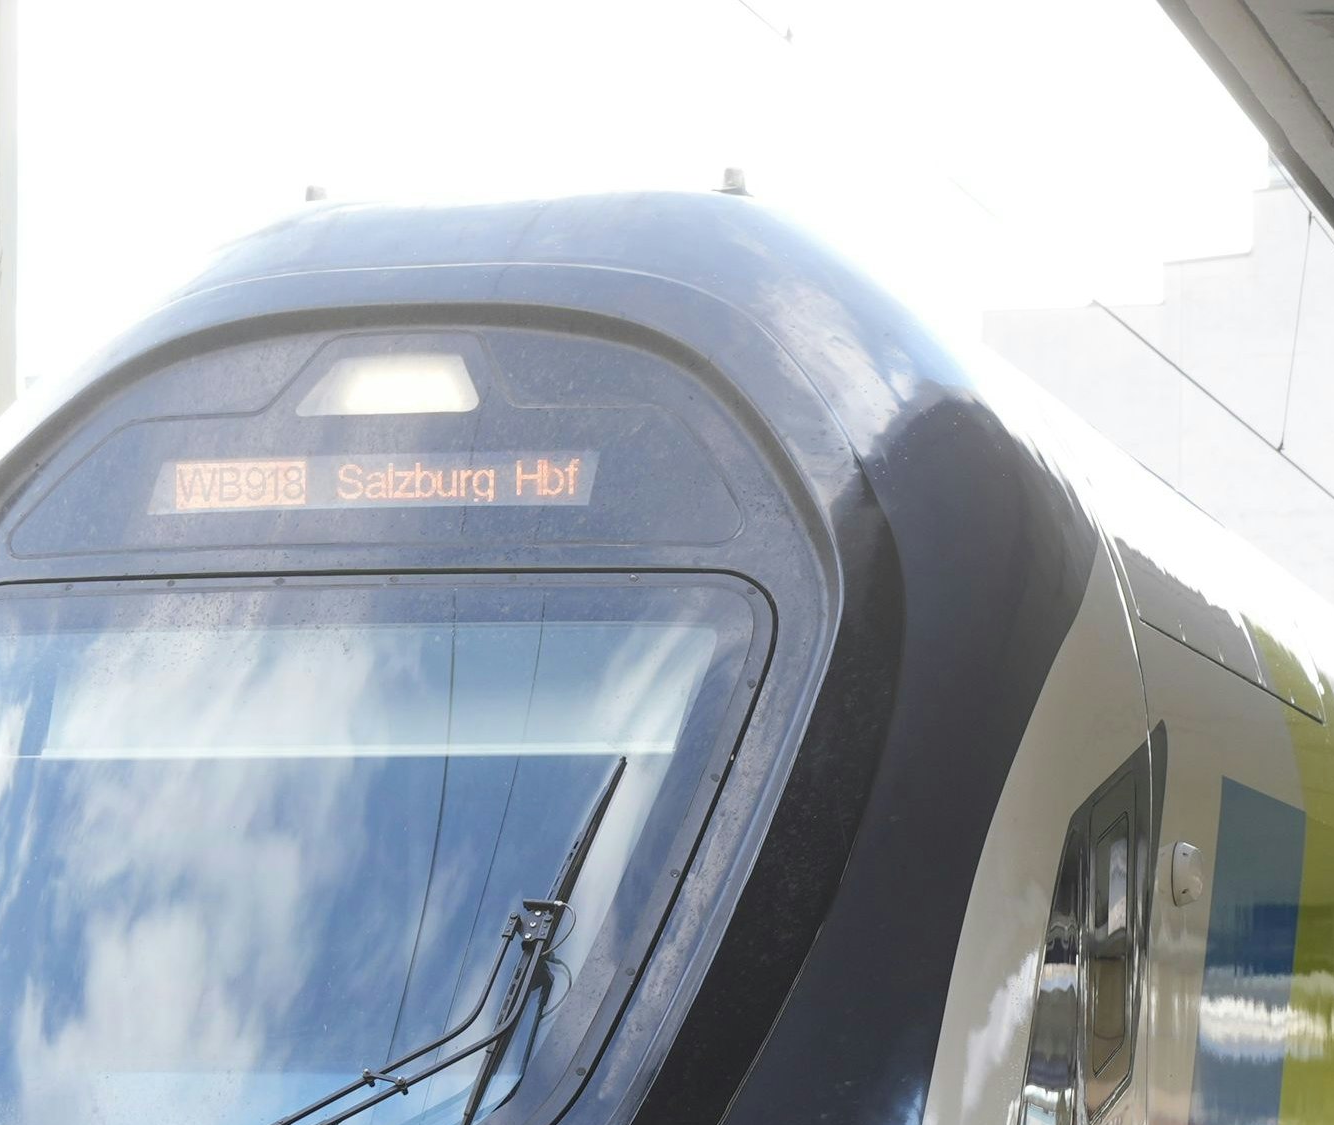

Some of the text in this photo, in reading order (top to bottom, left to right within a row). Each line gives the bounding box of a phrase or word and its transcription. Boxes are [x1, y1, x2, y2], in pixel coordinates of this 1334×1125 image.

[177, 458, 580, 503] WB918 Salzburg Hbf
